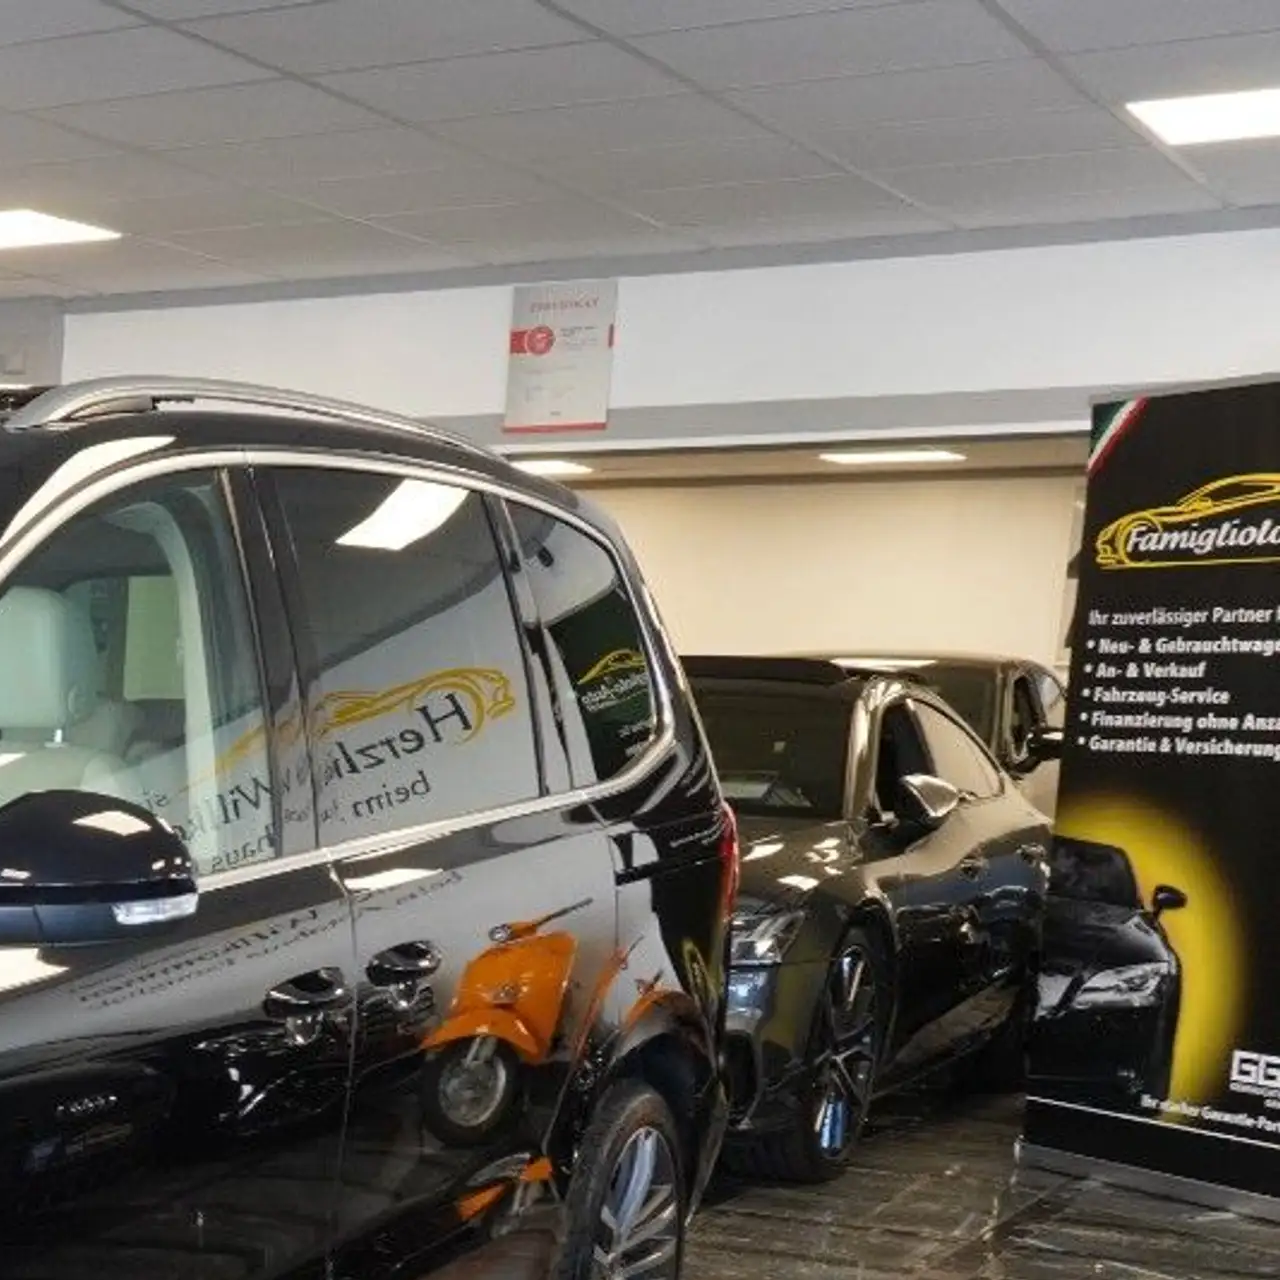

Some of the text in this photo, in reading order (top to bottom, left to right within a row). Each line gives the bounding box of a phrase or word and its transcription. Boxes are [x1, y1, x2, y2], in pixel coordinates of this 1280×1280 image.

[1088, 609, 1109, 625] Ihr
[1112, 607, 1209, 627] zuverlässiger
[1212, 606, 1273, 624] Partner
[1098, 638, 1135, 654] Neu-
[1138, 638, 1152, 654] &
[1095, 660, 1207, 678] An- & Verkauf
[1092, 686, 1231, 707] Fahrzeug-Service
[1091, 710, 1194, 733] Finanzierung
[1196, 712, 1239, 730] ohne
[1089, 734, 1157, 752] Garantie
[1159, 736, 1171, 753] &
